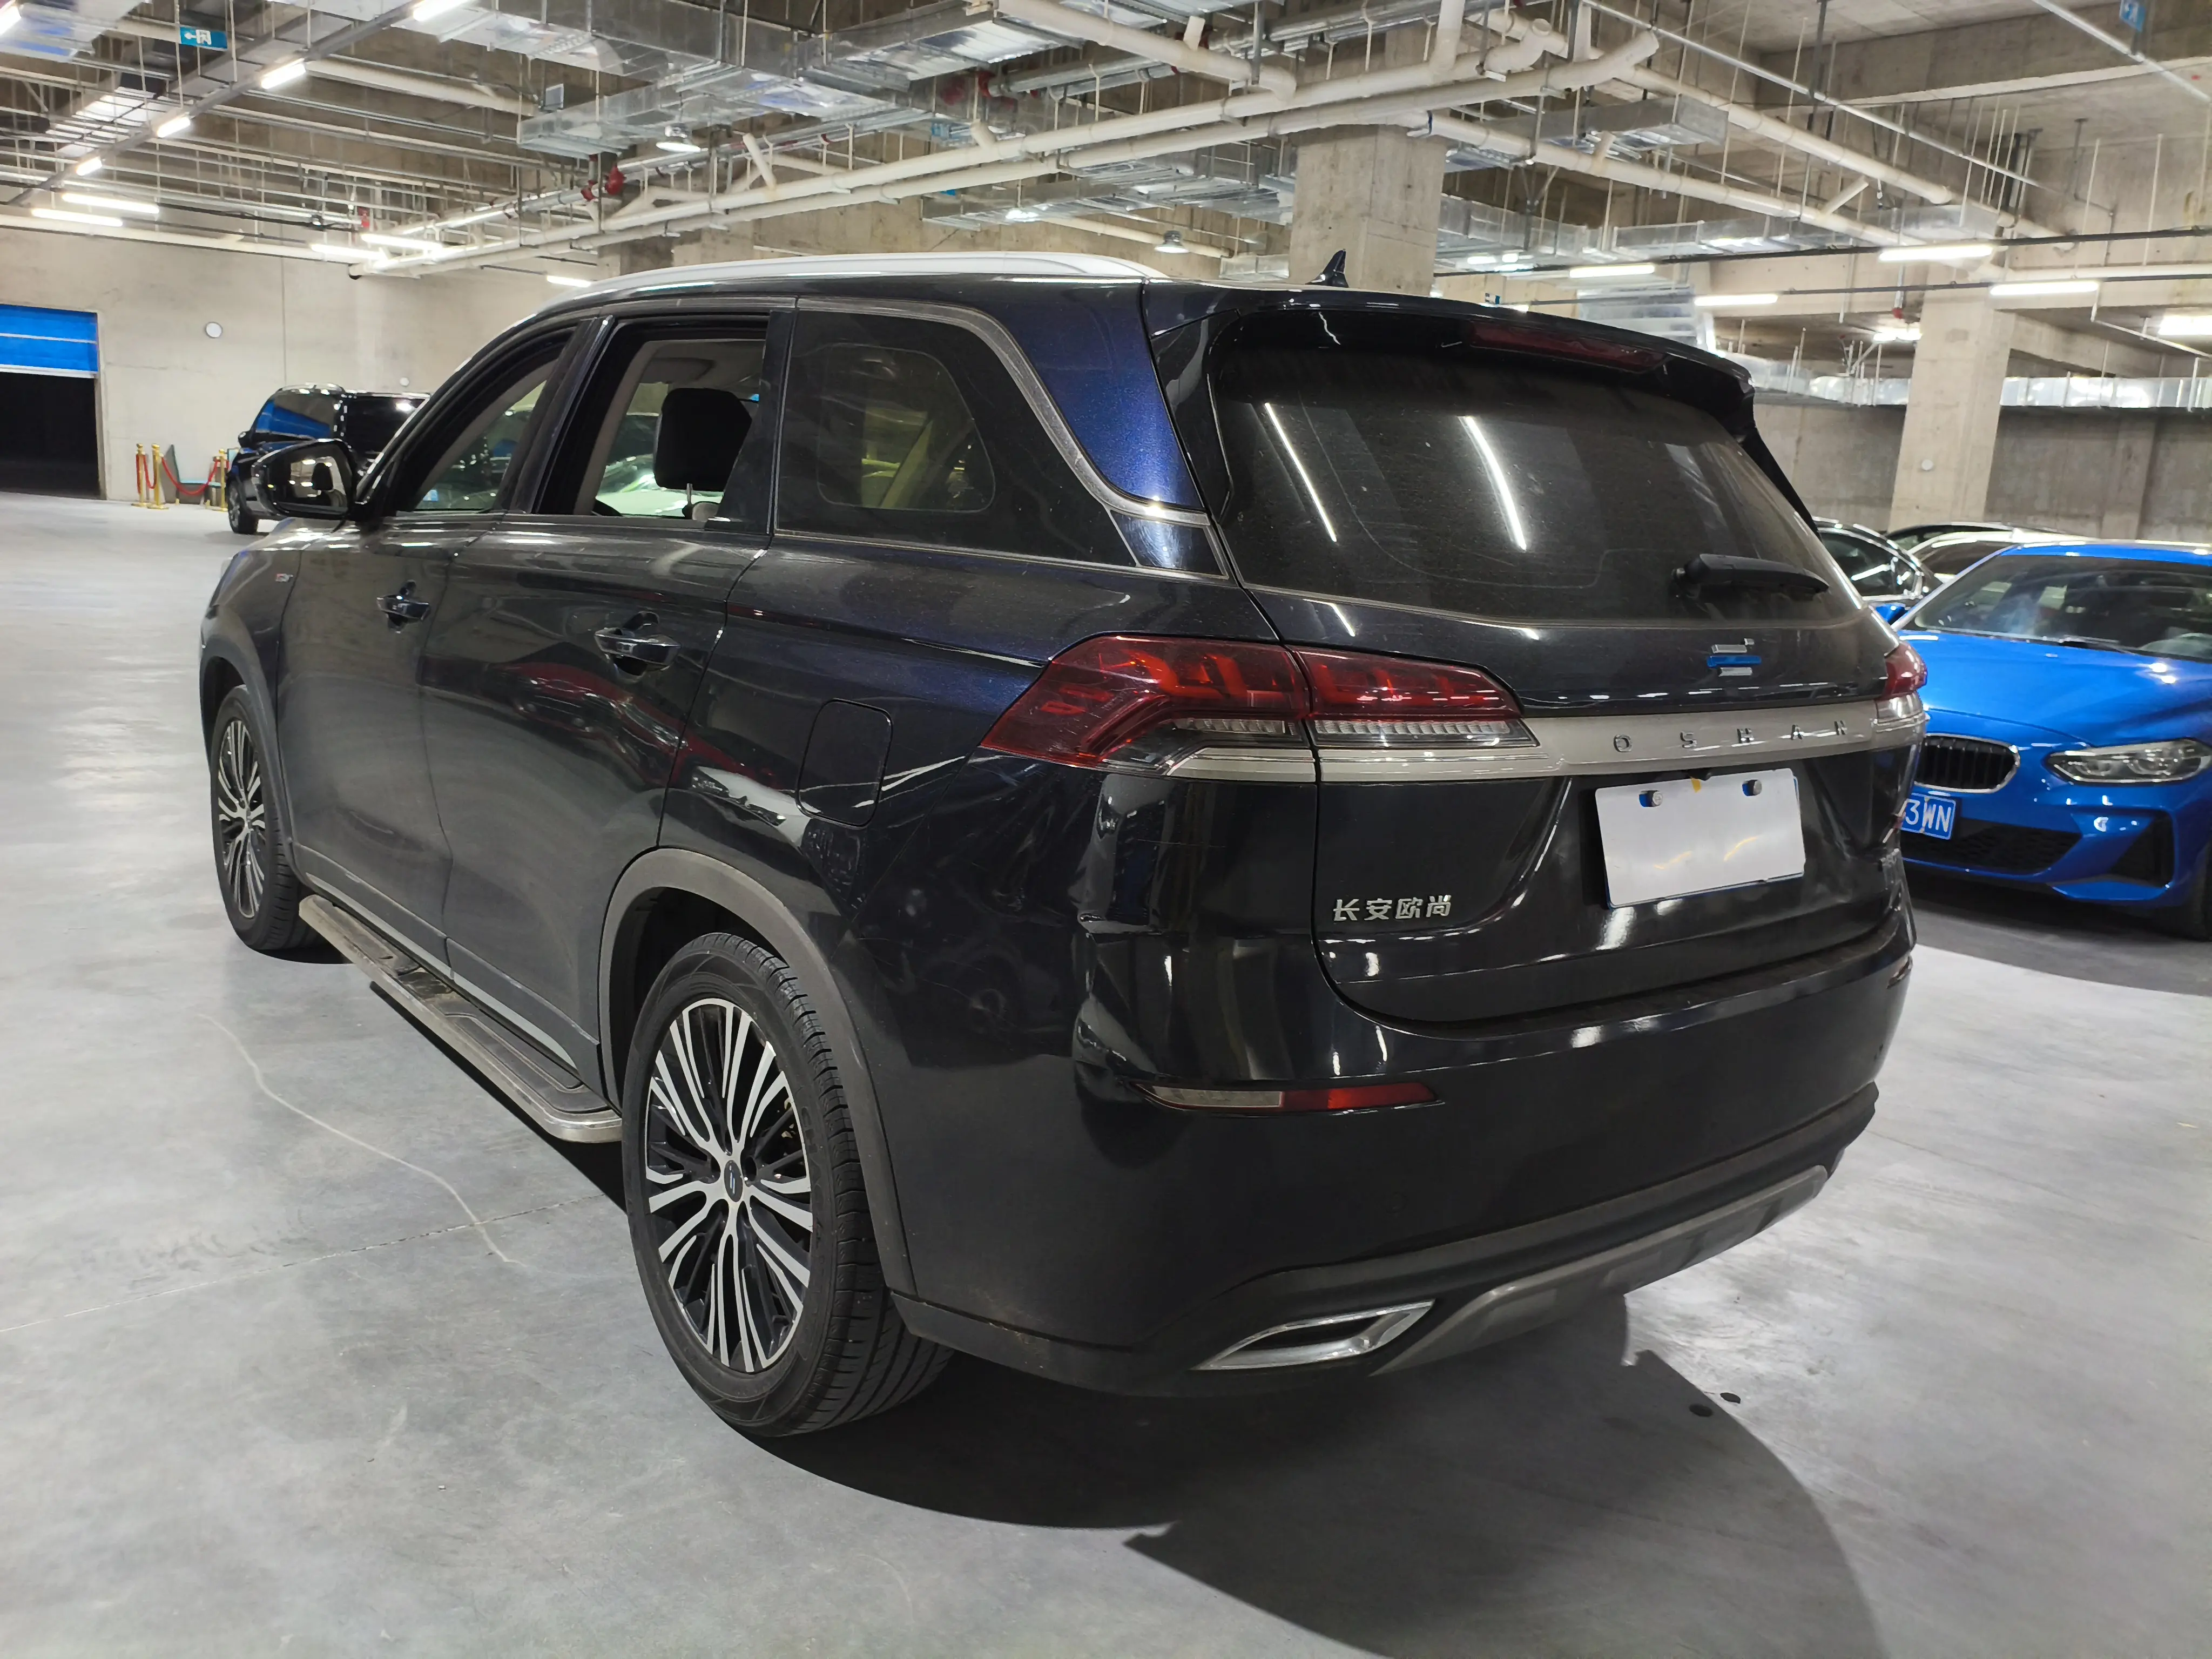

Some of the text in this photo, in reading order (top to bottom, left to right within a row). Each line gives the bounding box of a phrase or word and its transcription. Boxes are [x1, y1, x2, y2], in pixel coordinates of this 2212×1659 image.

[1613, 720, 1847, 753] OSHAN
[1333, 895, 1452, 922] 长安欧尚
